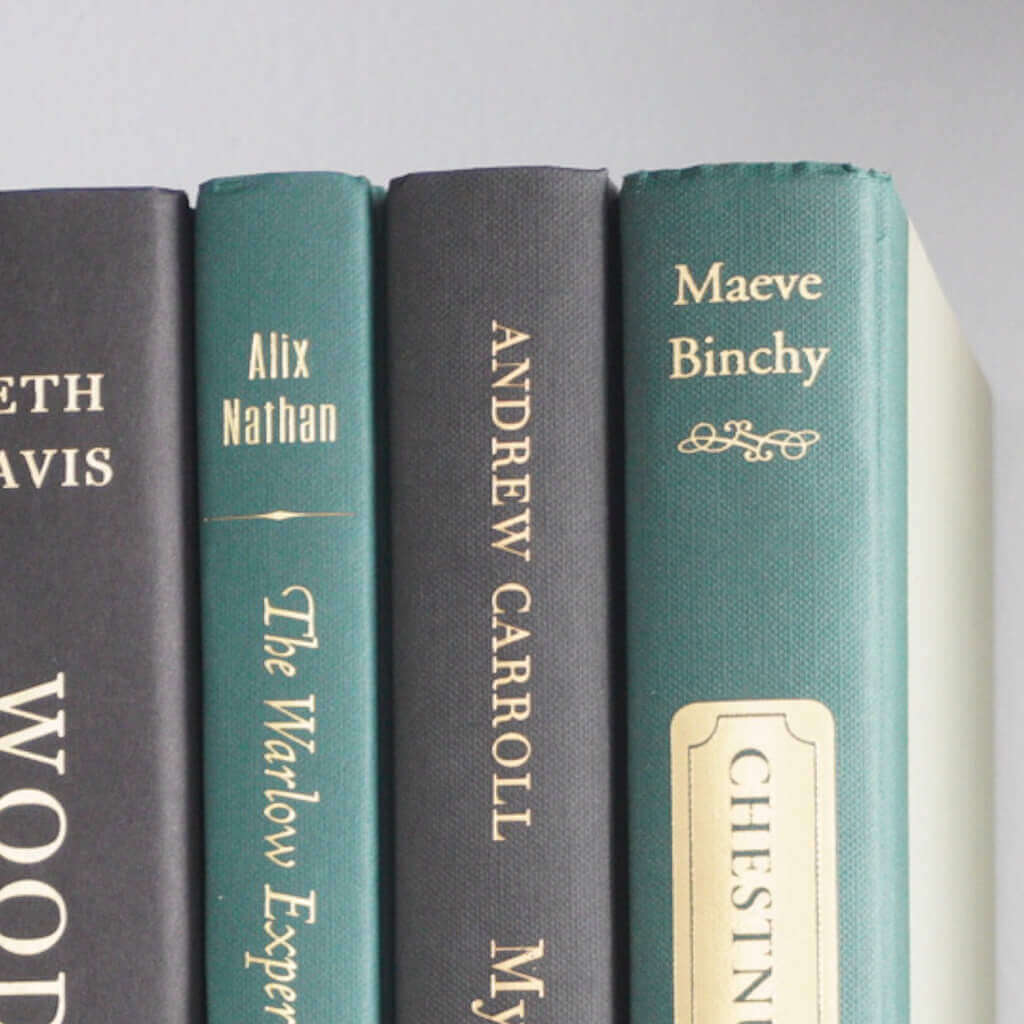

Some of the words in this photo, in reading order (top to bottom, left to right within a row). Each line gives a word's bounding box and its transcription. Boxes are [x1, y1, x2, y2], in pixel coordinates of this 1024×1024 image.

[673, 262, 823, 306] Maeve
[248, 331, 310, 381] Alix
[669, 330, 832, 388] Binchy
[223, 396, 337, 446] Nathan
[491, 319, 531, 562] ANDREW
[263, 585, 319, 677] The
[491, 582, 532, 841] CARROLL
[263, 693, 321, 868] Warlow
